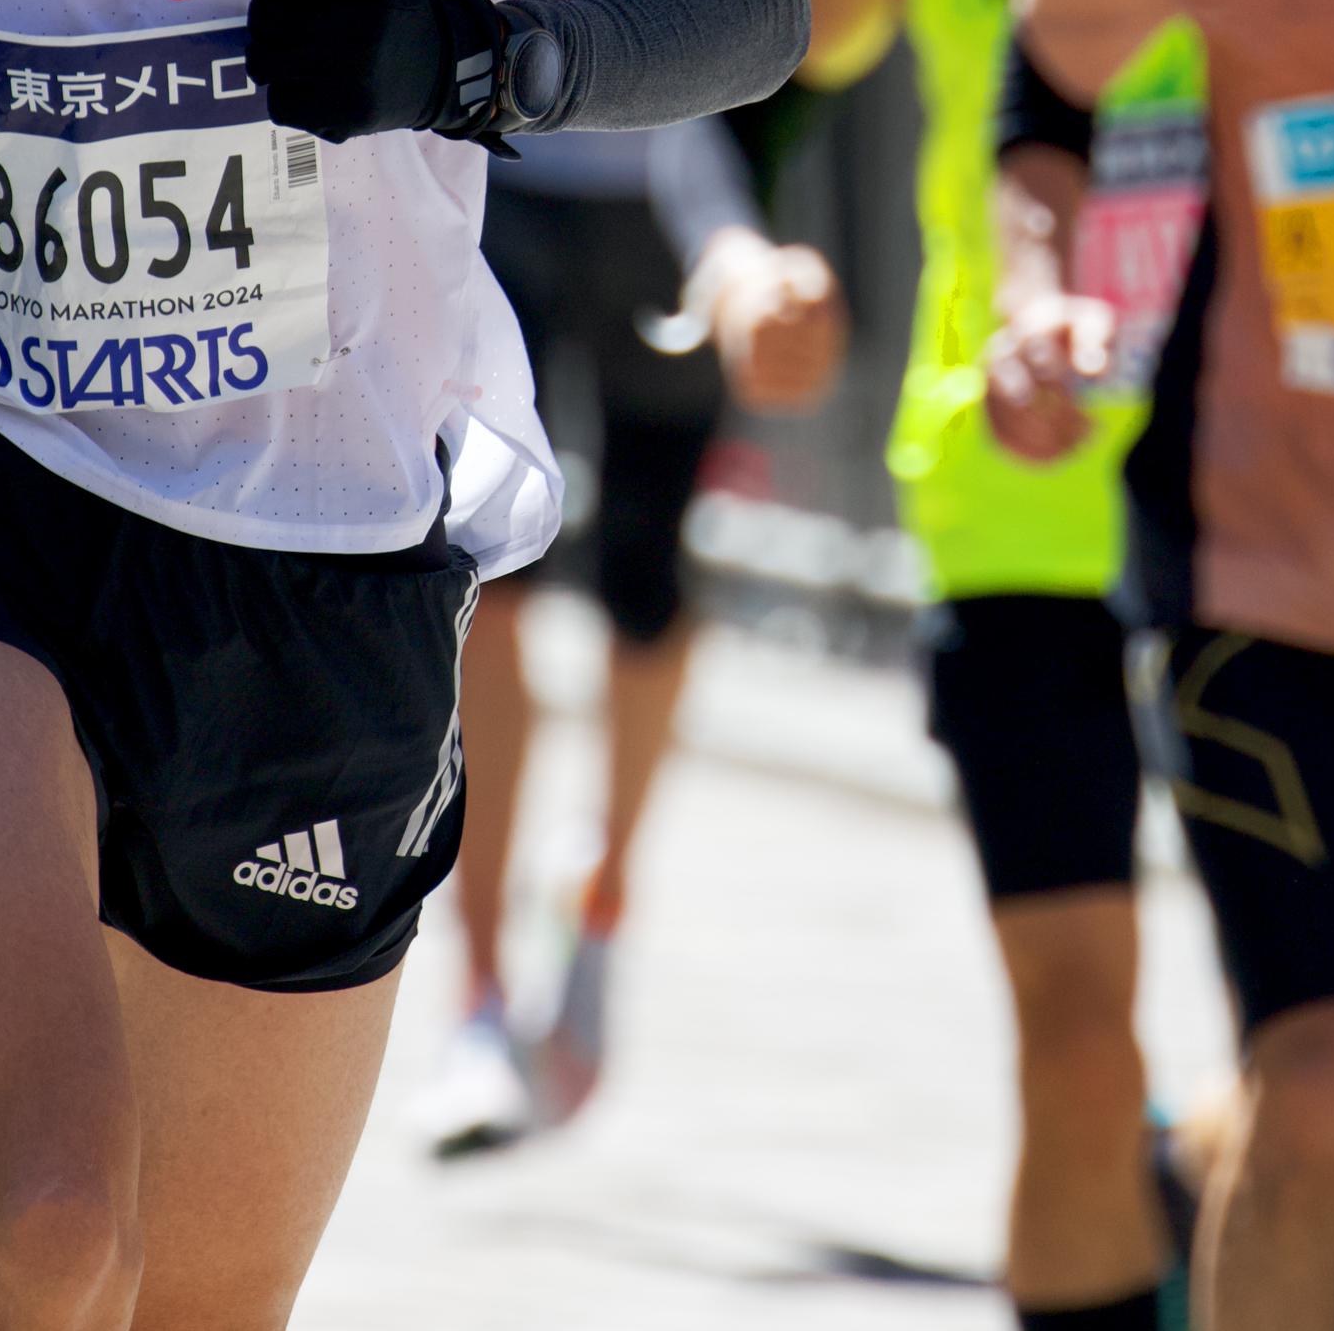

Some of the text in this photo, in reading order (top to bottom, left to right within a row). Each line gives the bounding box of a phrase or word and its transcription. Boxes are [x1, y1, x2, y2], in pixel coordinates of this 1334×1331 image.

[6, 55, 257, 119] 東京メトロ
[50, 295, 195, 322] MARATHON
[203, 283, 264, 311] 2024
[233, 861, 359, 910] adidas
